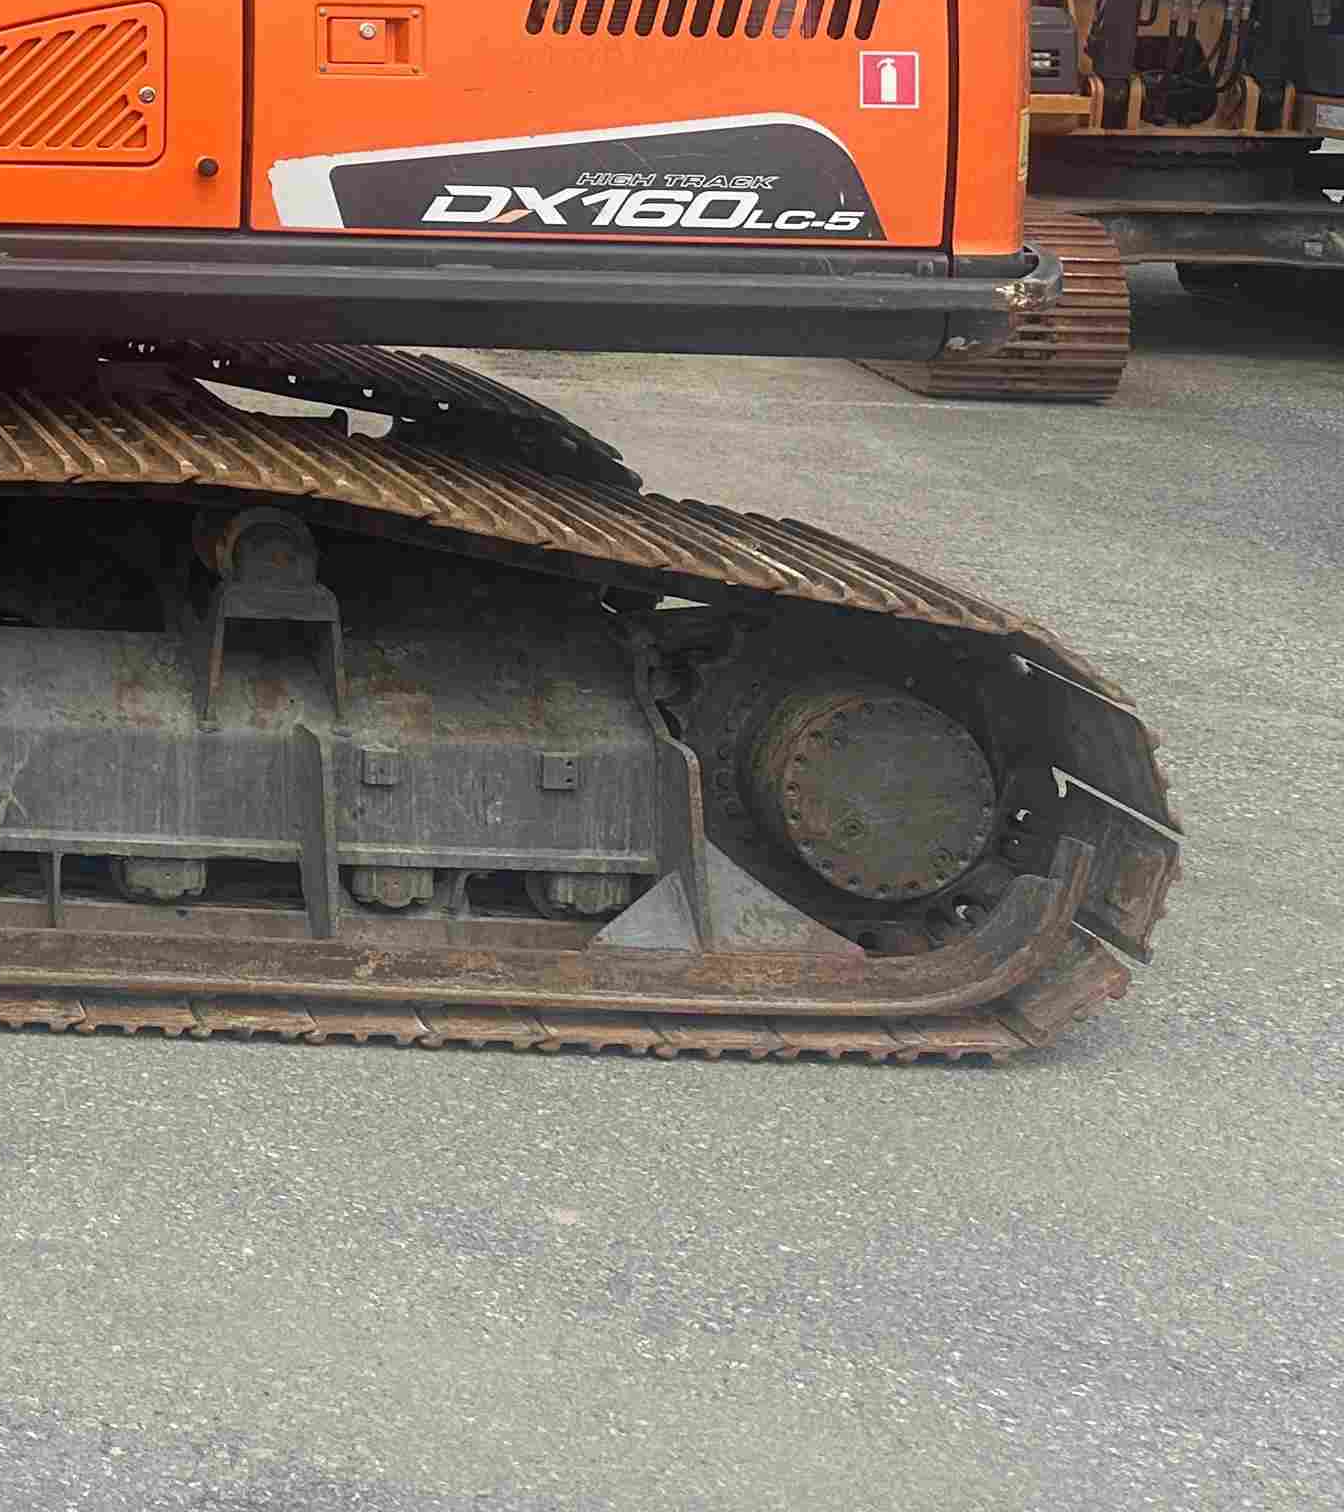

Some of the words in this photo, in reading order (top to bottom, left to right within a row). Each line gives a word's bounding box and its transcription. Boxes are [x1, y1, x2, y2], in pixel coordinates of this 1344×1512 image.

[576, 171, 657, 187] HIGH
[664, 173, 782, 190] TRACK
[419, 184, 866, 232] DX160LC-5
